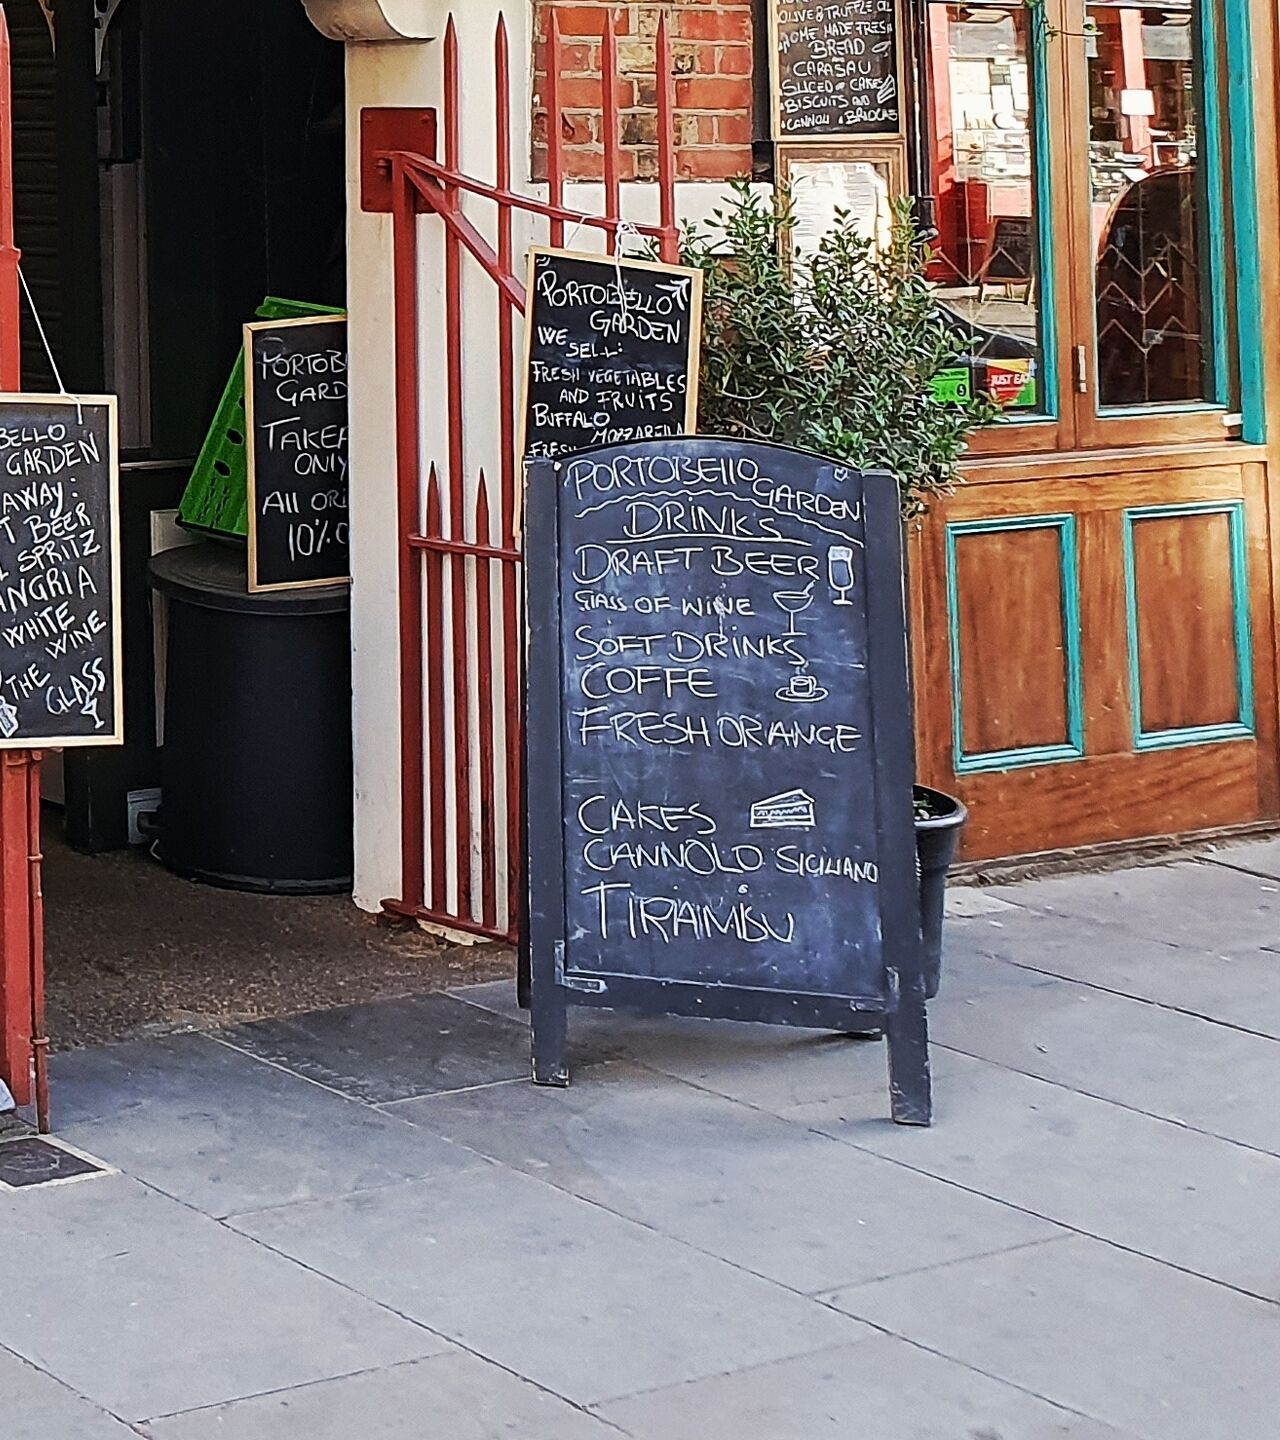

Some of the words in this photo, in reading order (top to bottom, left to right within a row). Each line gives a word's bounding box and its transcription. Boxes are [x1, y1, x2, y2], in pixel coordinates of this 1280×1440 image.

[537, 271, 672, 315] PORTOBELLO
[538, 326, 568, 346] WE
[590, 310, 680, 344] GARDEN
[530, 361, 580, 383] FRESH
[589, 368, 686, 394] VEGETABLES
[531, 403, 610, 428] BUFFALO
[559, 388, 589, 404] AND
[596, 389, 673, 412] FRUITS
[6, 433, 100, 477] GARDEN
[623, 496, 785, 539] DRINKS
[752, 476, 861, 520] GARDEN
[23, 502, 91, 545] BEER
[18, 529, 101, 574] SPRITZ
[572, 544, 704, 584] DRAFT
[710, 546, 820, 580] BEER
[634, 596, 672, 613] OF
[682, 595, 756, 617] WINE
[45, 610, 107, 660] WINE
[574, 625, 666, 661] SOFT
[668, 625, 806, 666] DRINKS
[5, 663, 51, 702] THE
[46, 656, 107, 715] GLASS
[580, 662, 719, 703] COFFE
[572, 706, 711, 747] FRESH
[716, 715, 862, 753] ORANGE
[577, 795, 717, 835] CAKES
[583, 838, 764, 875] CANNOLO
[775, 844, 880, 883] SICILIANO
